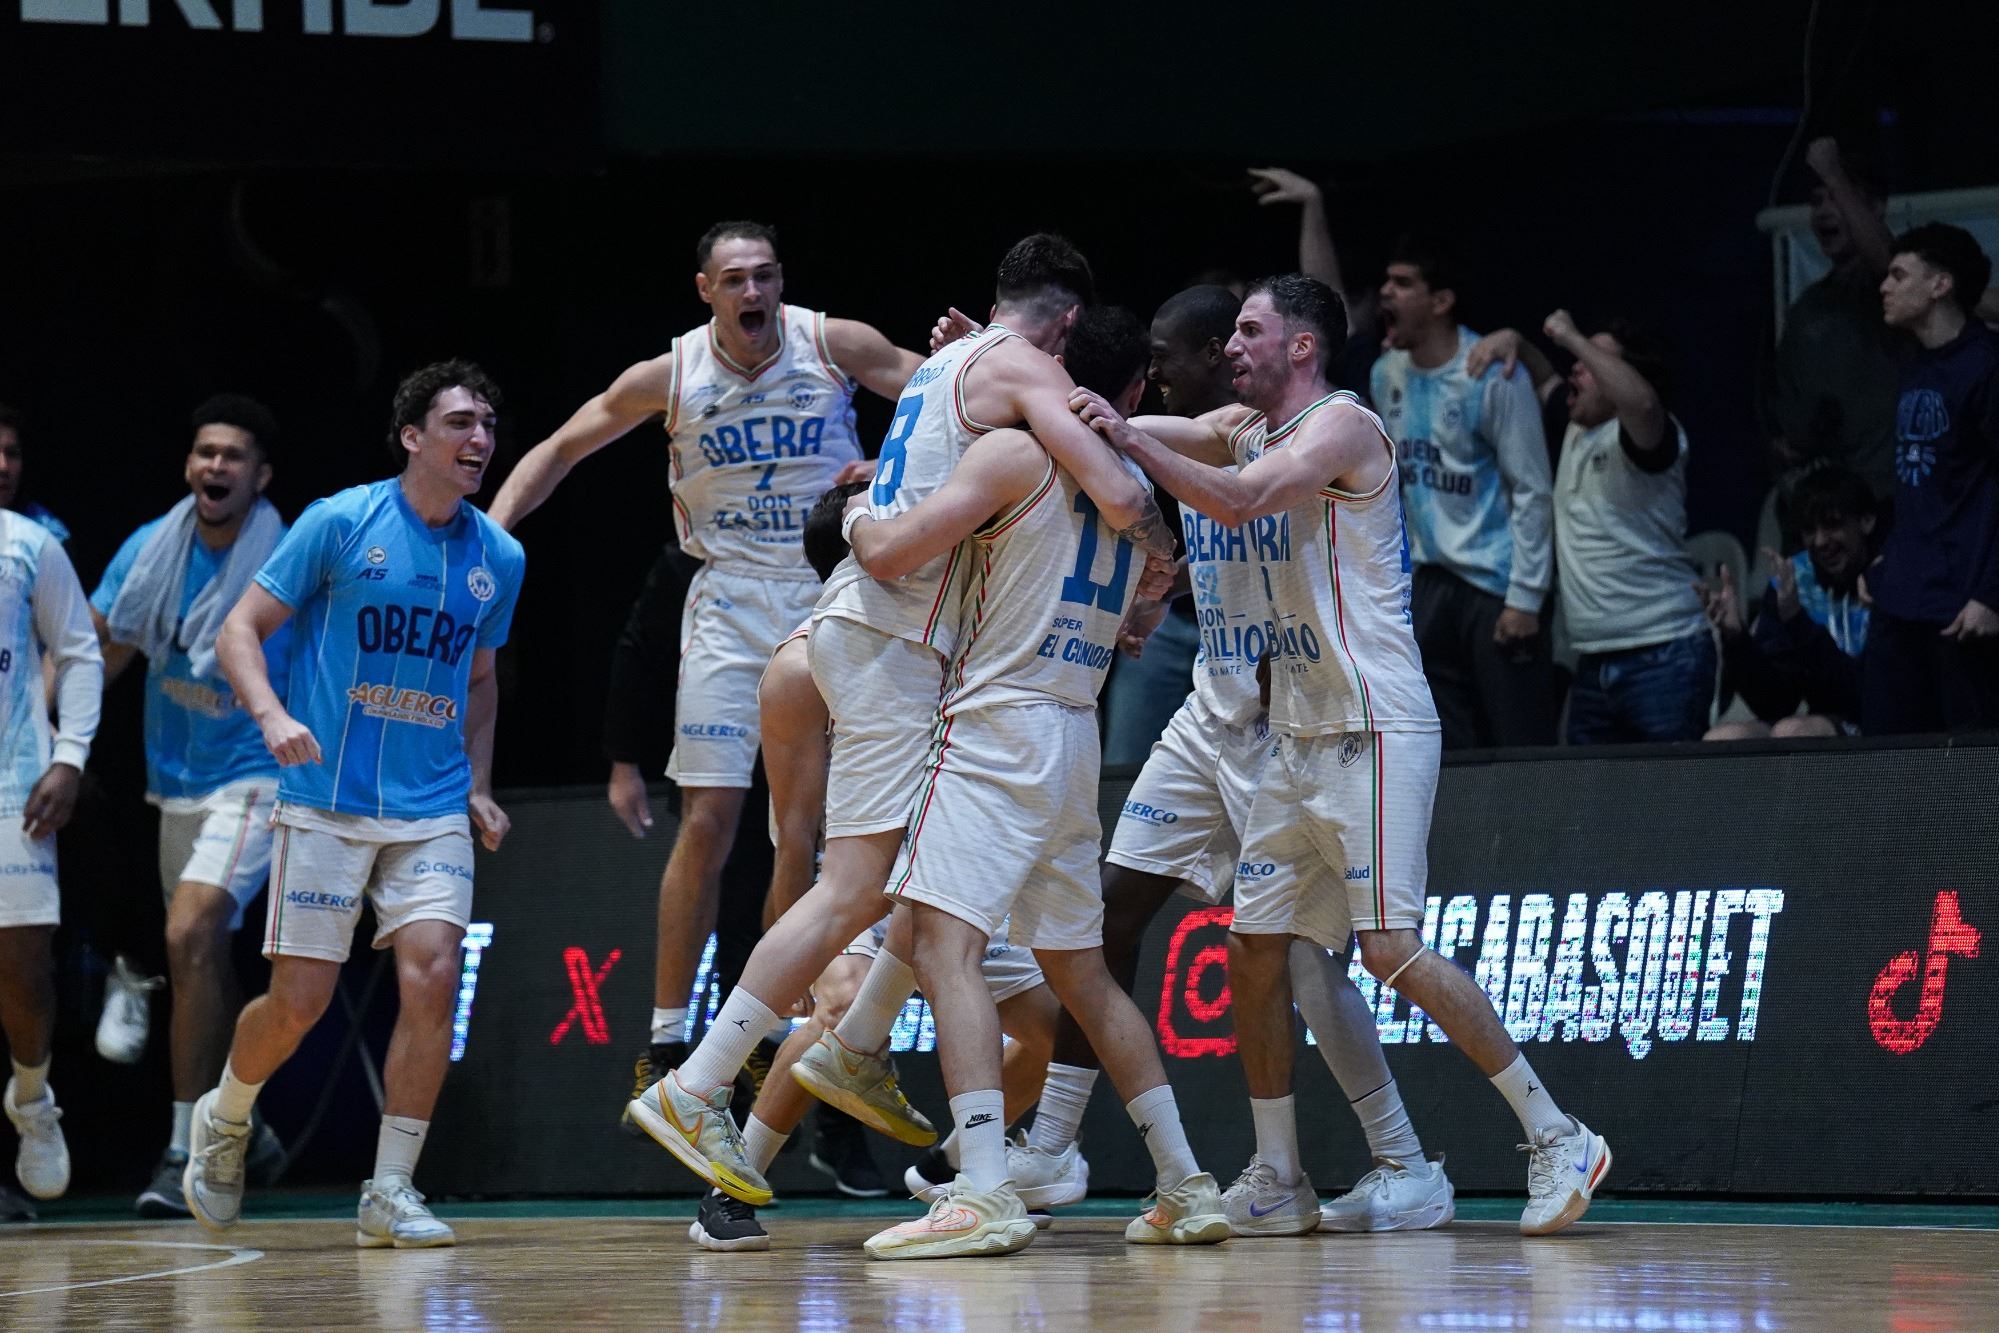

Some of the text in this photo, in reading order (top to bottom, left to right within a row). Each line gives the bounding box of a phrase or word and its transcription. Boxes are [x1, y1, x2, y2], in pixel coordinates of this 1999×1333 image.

[699, 416, 825, 468] OBERA
[873, 393, 924, 507] 8
[752, 462, 778, 491] 7
[747, 494, 792, 512] DON
[1198, 608, 1226, 628] DON
[357, 604, 476, 668] OBERA
[1037, 633, 1060, 659] EL
[970, 1113, 993, 1123] NIKE
